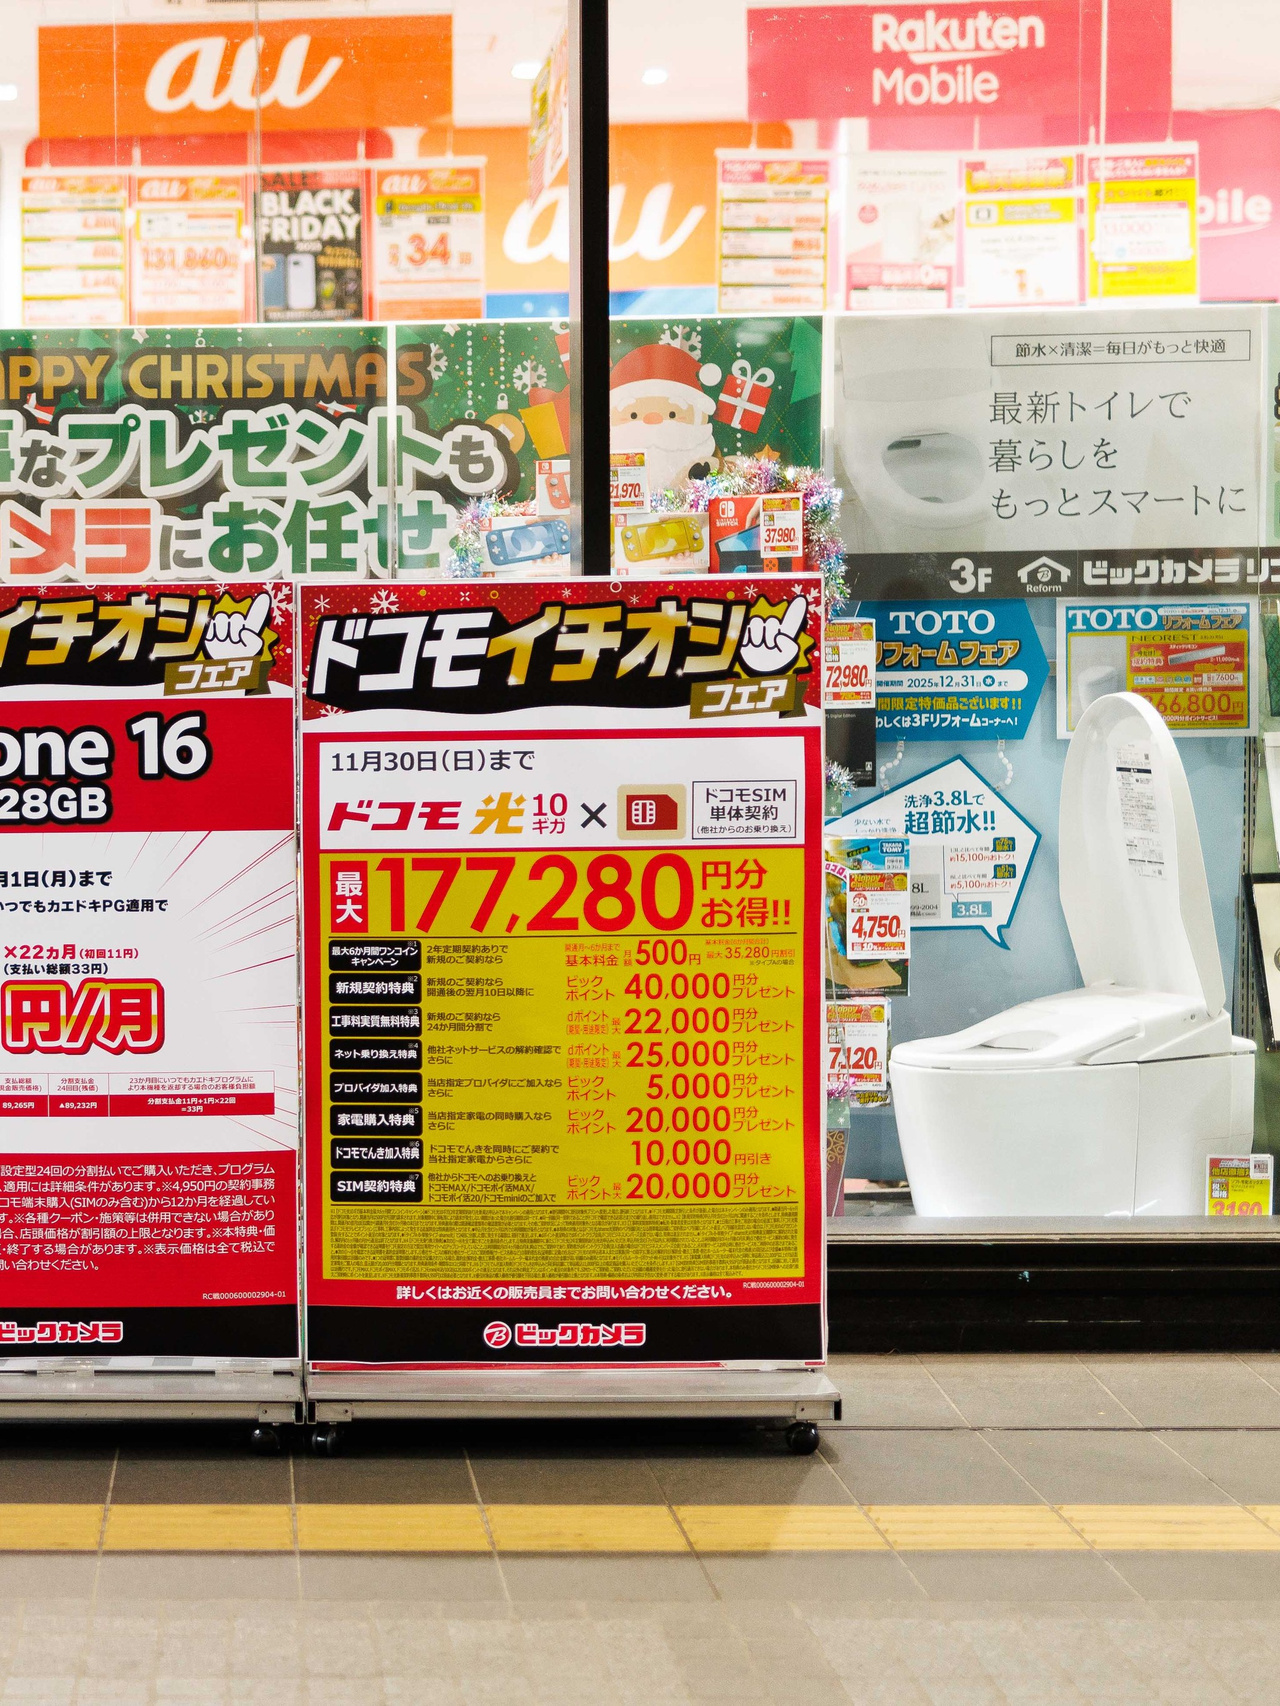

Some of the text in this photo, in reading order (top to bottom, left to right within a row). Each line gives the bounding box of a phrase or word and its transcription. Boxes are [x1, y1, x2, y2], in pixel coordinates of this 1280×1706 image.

[872, 11, 1045, 53] Rakuten
[145, 34, 343, 113] au
[873, 67, 1000, 106] Mobile
[262, 191, 355, 216] BLACK
[261, 215, 361, 240] FRIDAY
[129, 351, 427, 400] CHRISTMAS
[988, 390, 1192, 425] 最新トイレで
[988, 437, 1118, 473] 暮らしを
[991, 485, 1246, 520] もっとスマートに
[949, 558, 992, 593] 3F
[1083, 558, 1240, 584] ビックカメラ
[1026, 583, 1062, 594] Reform
[889, 611, 995, 635] TOTO
[1069, 608, 1158, 631] TOTO
[312, 600, 747, 695] ドコモイチオシ
[175, 661, 254, 689] フェア
[826, 665, 873, 689] 72,980円
[702, 680, 789, 714] フェア
[131, 715, 207, 776] 16
[331, 750, 536, 773] 11月30日(日)まで
[704, 787, 787, 804] ドコモSIM
[904, 790, 985, 809] 洗浄3.8Lで
[709, 804, 779, 822] 単体契約
[904, 809, 996, 835] 超節水!!
[696, 824, 792, 836] (他社からのお乗り換え)
[375, 853, 694, 936] 177,280
[957, 904, 988, 916] 3.8L
[852, 915, 906, 941] 4,750円
[351, 957, 399, 967] キャンペーン
[426, 945, 508, 955] 2年定期契約ありで
[426, 955, 503, 965] 新規のご契約なら
[635, 938, 687, 966] 500
[3, 962, 109, 976] (支払い総額33円)
[336, 981, 415, 995] 新規契約特典
[426, 978, 504, 987] 新規のご契約なら
[426, 988, 535, 997] 開通後の翌月10日以降に
[624, 972, 730, 1000] 40,000
[331, 1015, 420, 1028] 工事料実質無料特典
[624, 1006, 730, 1035] 22,000
[334, 1048, 418, 1059] ネット乗り換え特典
[626, 1040, 730, 1068] 25,000
[334, 1082, 418, 1093] プロバイダ加入特典
[646, 1072, 730, 1100] 5,000
[2, 1101, 35, 1109] 89,265円
[337, 1113, 415, 1126] 家電購入特典
[625, 1105, 731, 1133] 20,000
[335, 1146, 420, 1160] ドコモでんき加入特典
[631, 1139, 731, 1166] 10,000
[734, 1153, 771, 1165] 円引き
[337, 1180, 416, 1192] SIM契約特典
[626, 1171, 731, 1199] 20,000
[395, 1285, 733, 1301] 詳しくはお近くの販売員までお問い合わせください。
[515, 1322, 647, 1348] ビックカメラ
